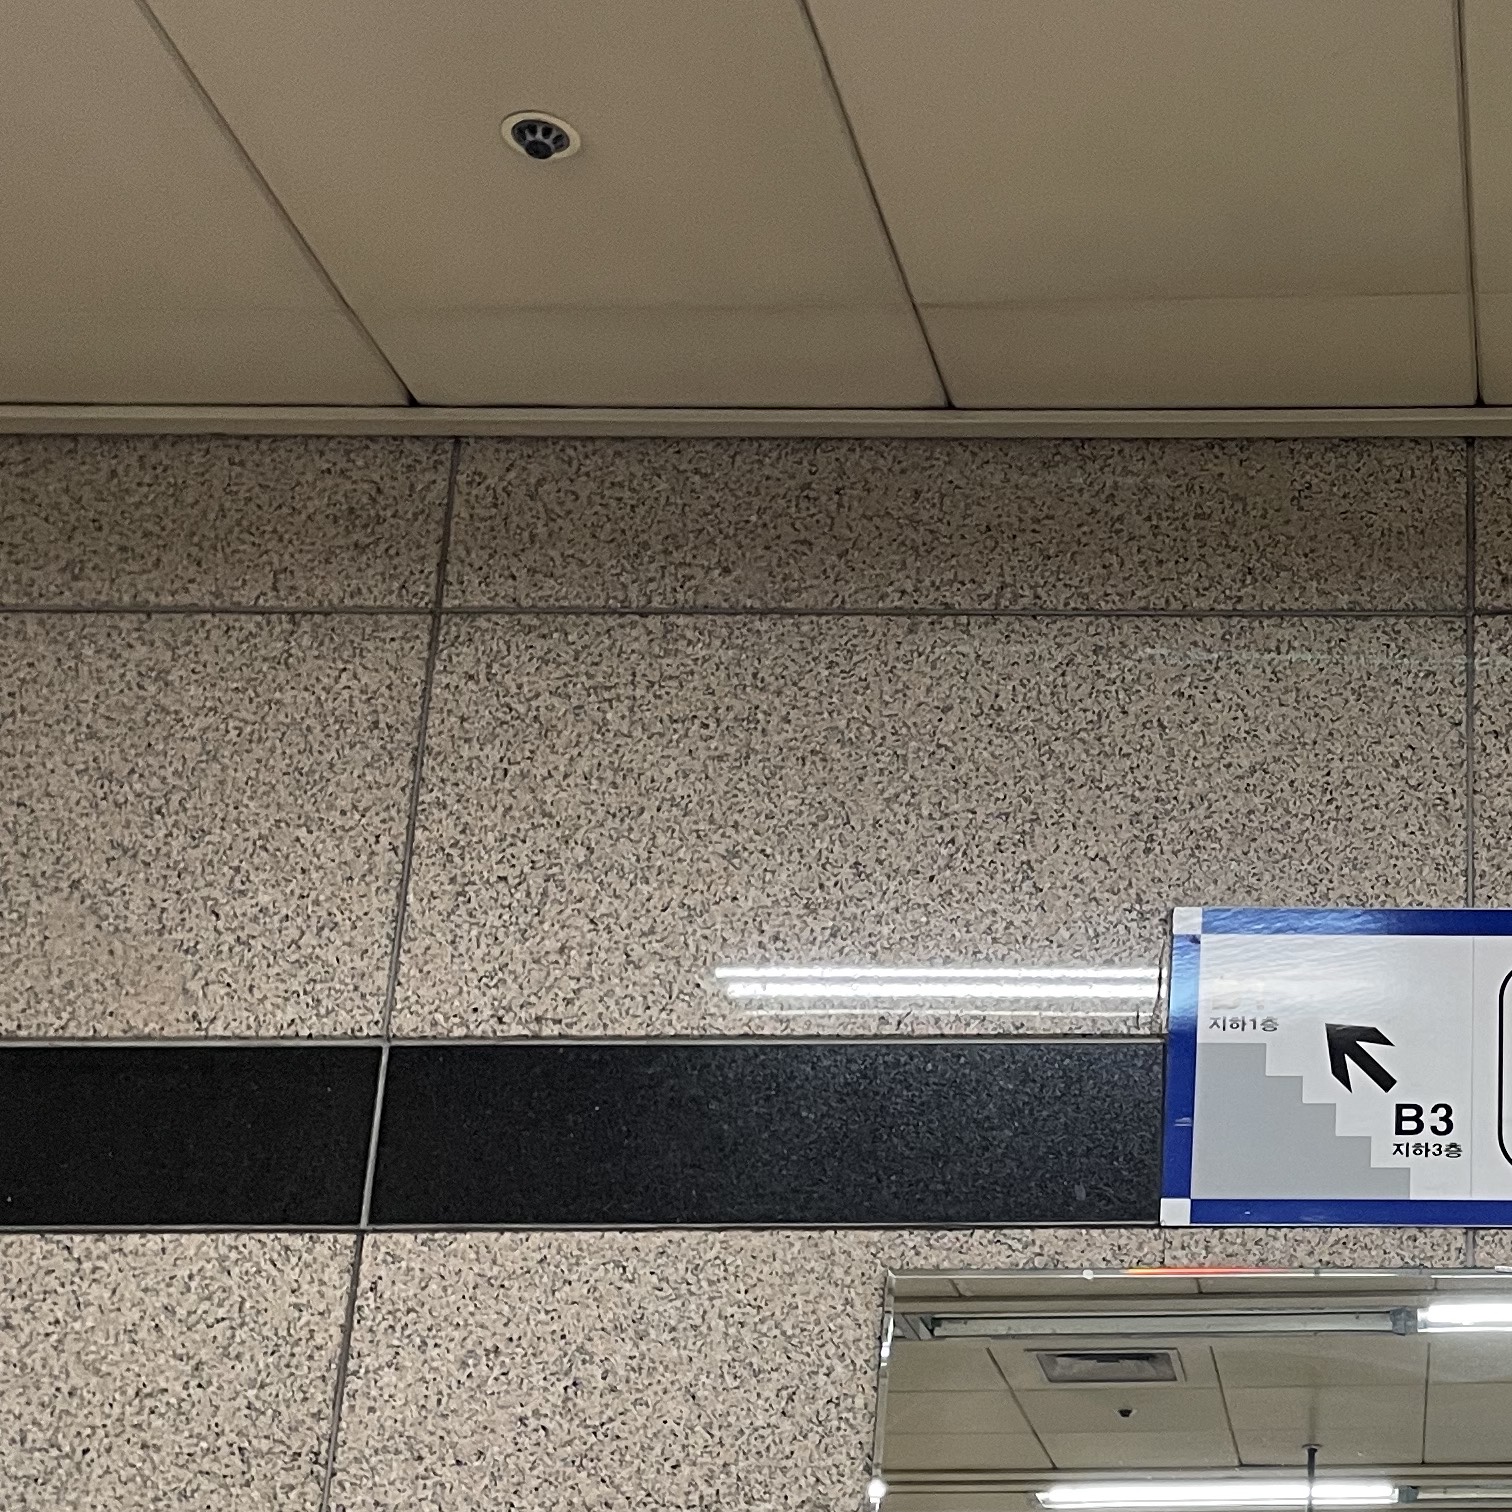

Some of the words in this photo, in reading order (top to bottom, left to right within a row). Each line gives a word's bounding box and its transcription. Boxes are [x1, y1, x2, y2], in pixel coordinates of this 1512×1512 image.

[1208, 1016, 1279, 1032] 지하1층
[1394, 1103, 1454, 1137] B3
[1392, 1142, 1462, 1158] 지하3층
